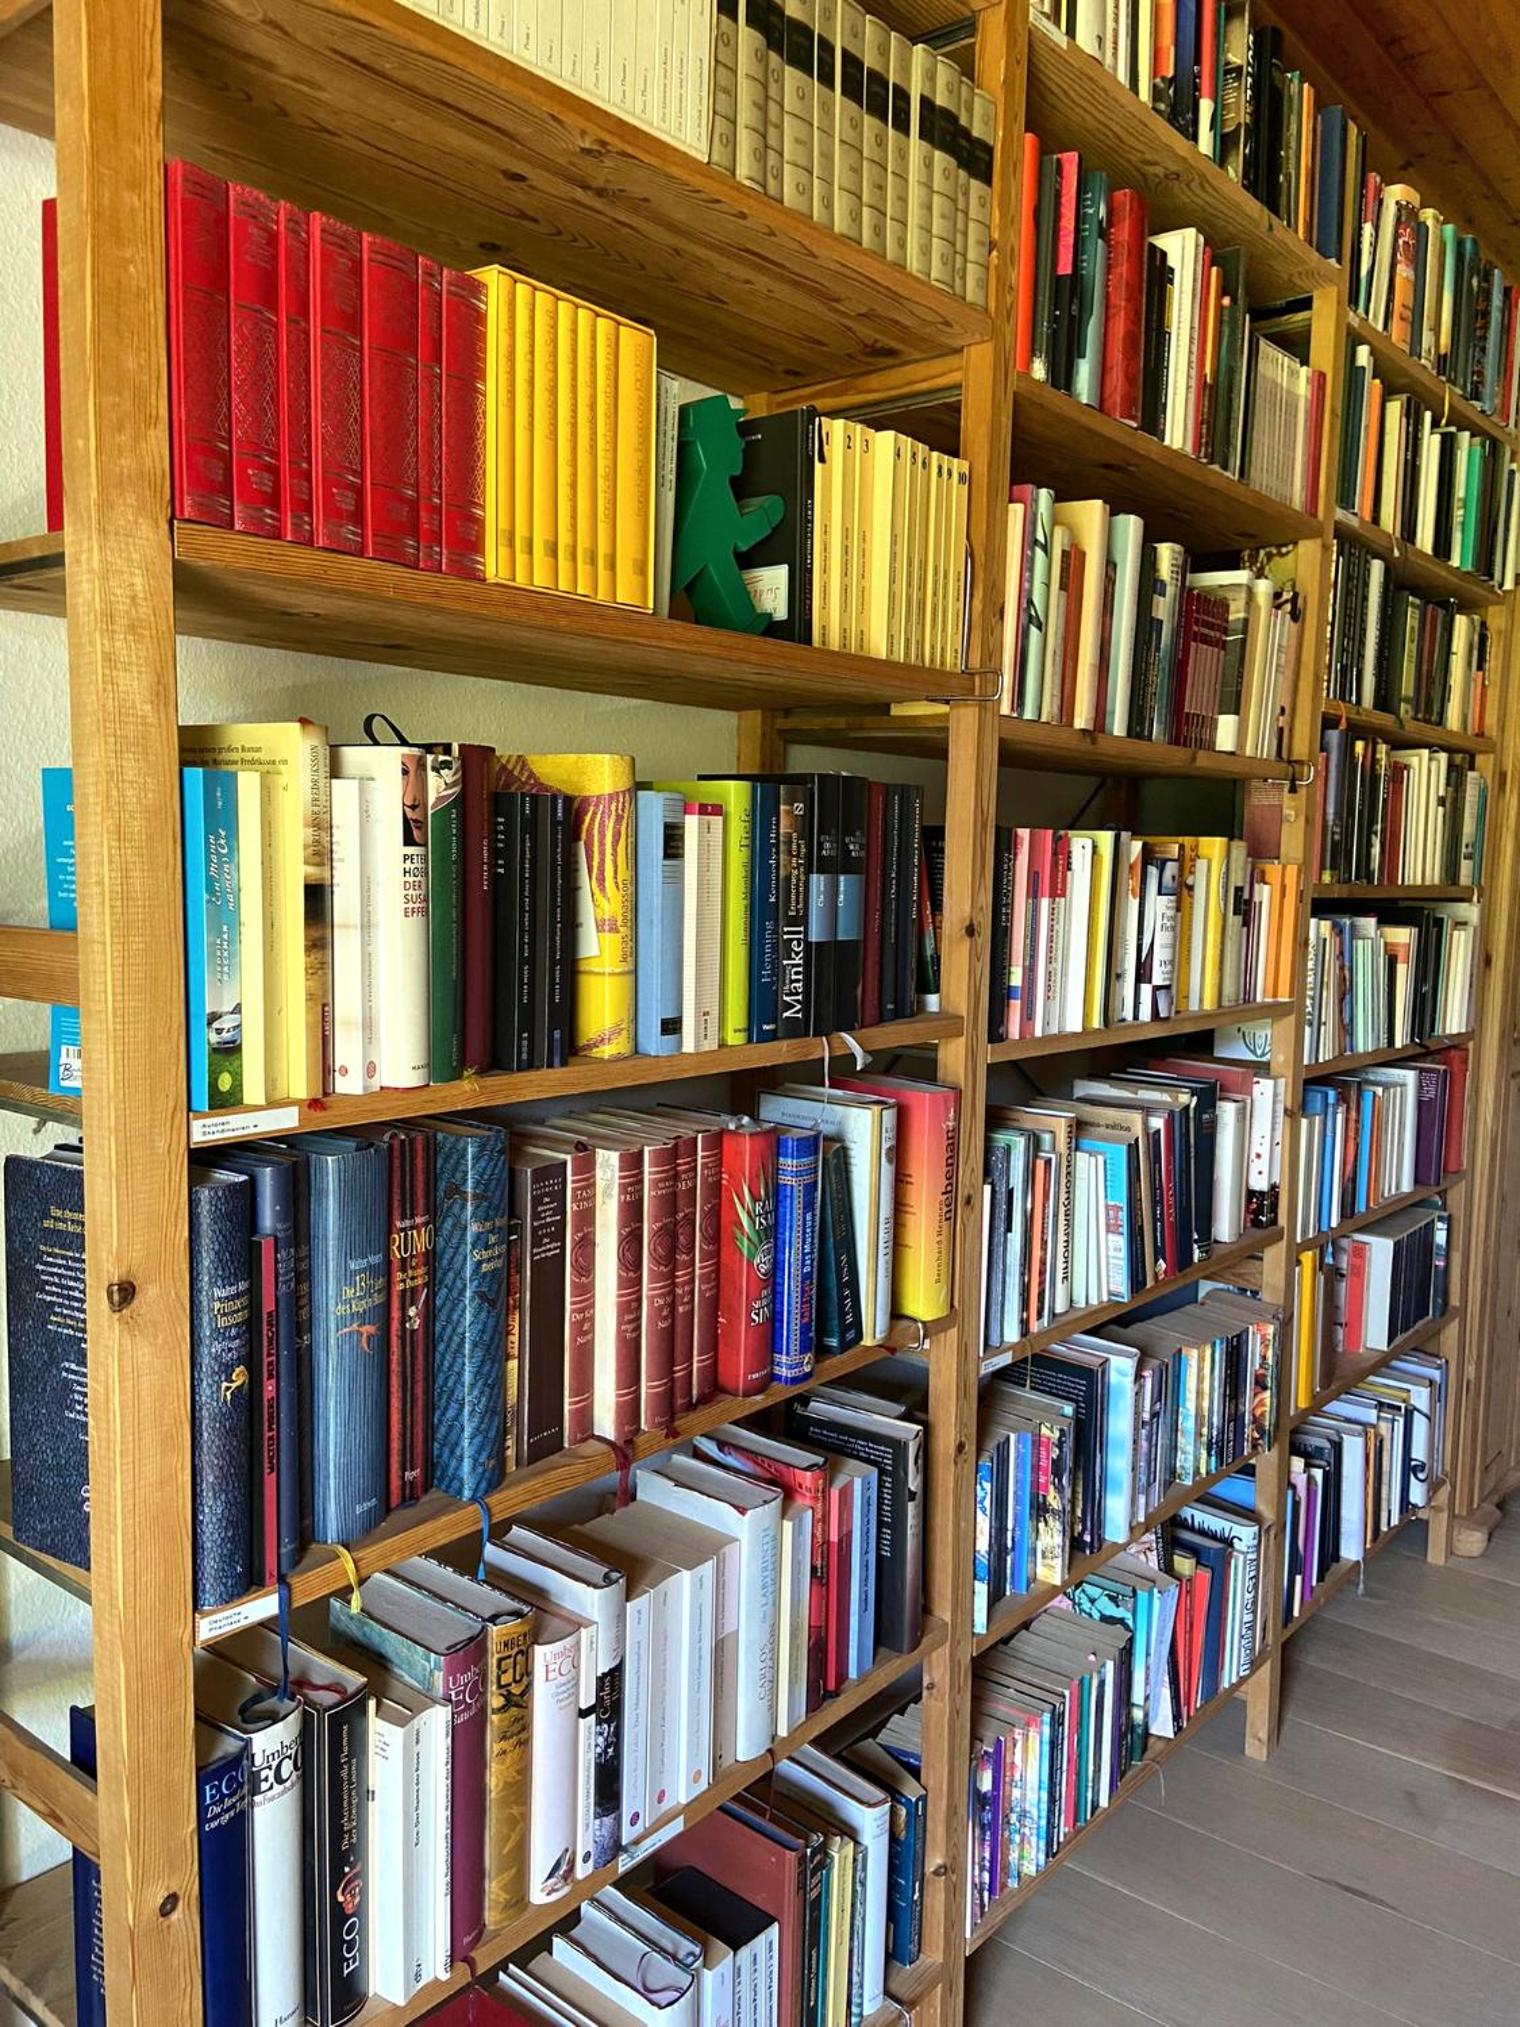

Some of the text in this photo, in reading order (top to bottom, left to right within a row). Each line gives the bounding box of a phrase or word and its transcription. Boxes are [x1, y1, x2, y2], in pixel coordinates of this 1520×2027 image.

[846, 434, 854, 450] 2
[862, 438, 870, 454] 3
[895, 446, 902, 463] 4
[957, 471, 968, 487] 10
[309, 743, 322, 858] MARIANNE FREDRIKSSON
[739, 807, 752, 853] Tiefe
[617, 878, 630, 964] Jonas Jonasson
[761, 920, 775, 983] Henning
[782, 925, 805, 1020] Mankell
[941, 1127, 956, 1223] nebenan
[389, 1222, 435, 1261] RUMO
[803, 1211, 812, 1254] Museum
[933, 1199, 944, 1285] Bernhard Hennen
[803, 1255, 811, 1274] Das
[757, 1525, 771, 1702] CARLOS LABYRINTH
[599, 1676, 612, 1720] Carlos
[340, 1725, 349, 1764] Flamme
[340, 1835, 349, 1852] Die
[342, 1917, 360, 1979] ECO
